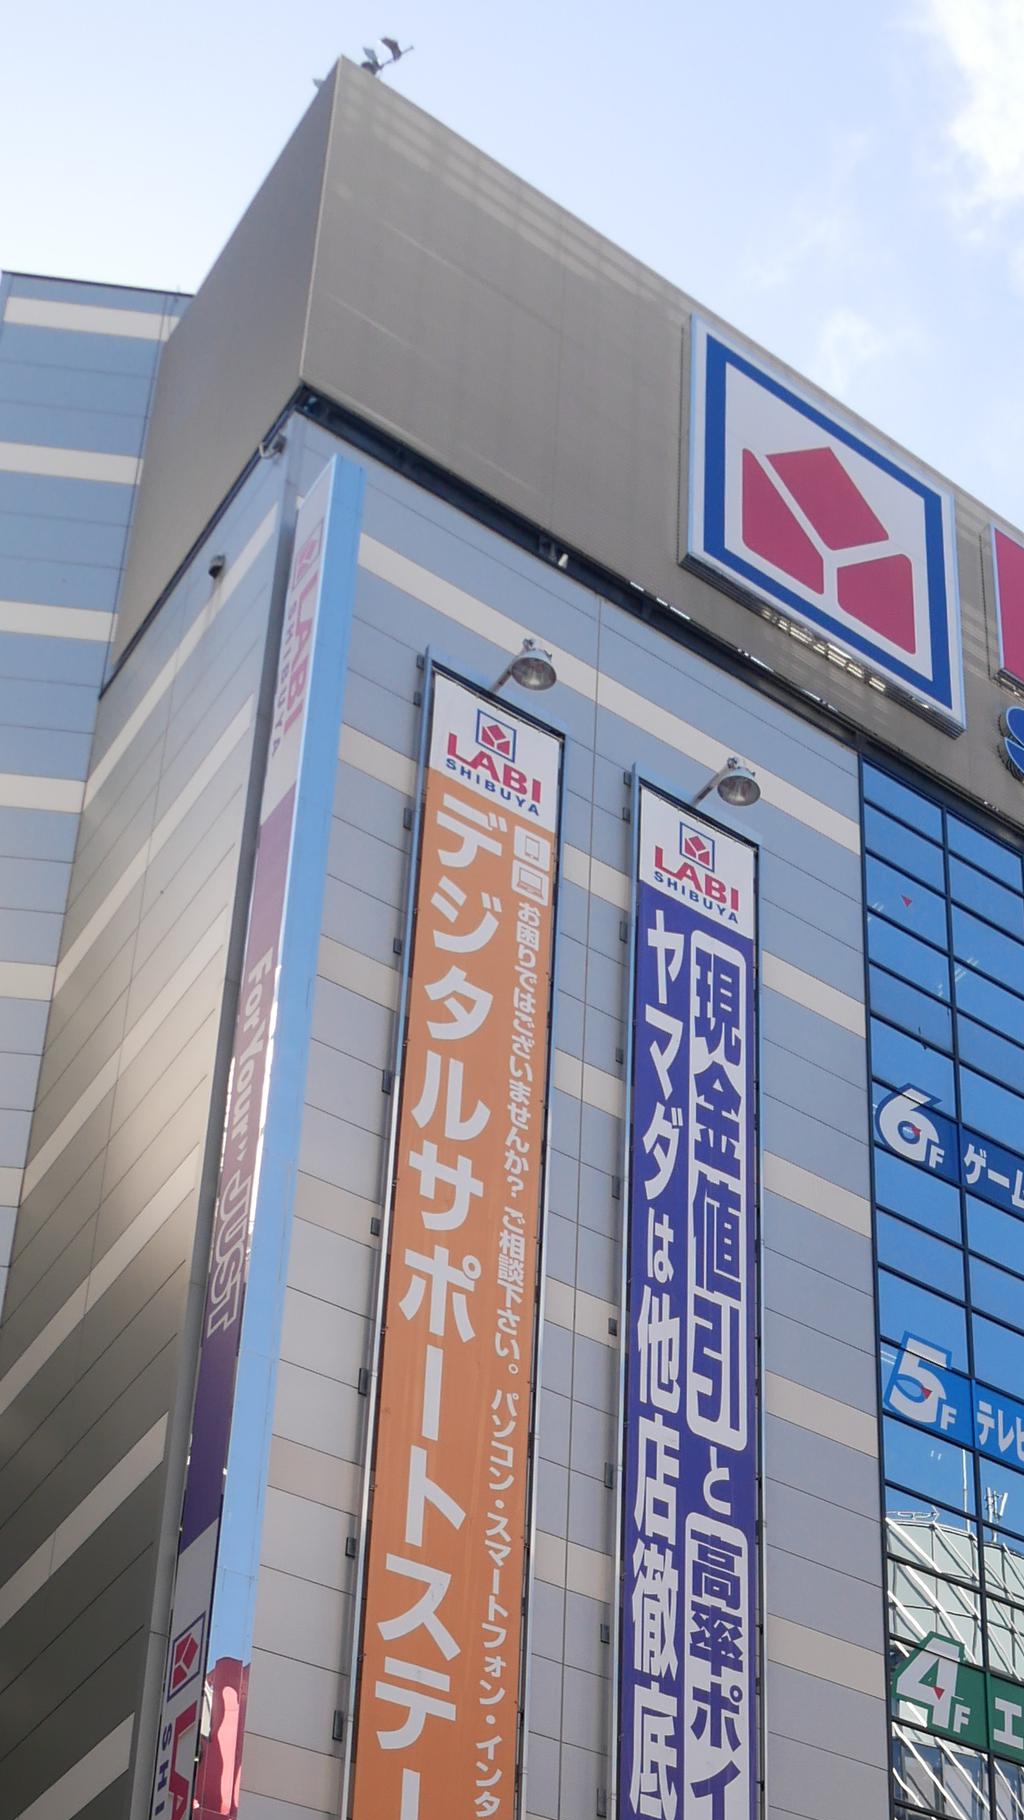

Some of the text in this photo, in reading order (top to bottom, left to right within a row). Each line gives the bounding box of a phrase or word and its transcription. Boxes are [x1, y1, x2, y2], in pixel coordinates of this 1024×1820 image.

[284, 570, 319, 735] LABI
[446, 758, 539, 816] SHIBUYA
[448, 732, 541, 803] LABI
[654, 871, 738, 924] SHIBUYA
[655, 846, 739, 912] LABI
[878, 1089, 945, 1168] 6F
[888, 1337, 957, 1431] 5F
[897, 1638, 970, 1734] 4F
